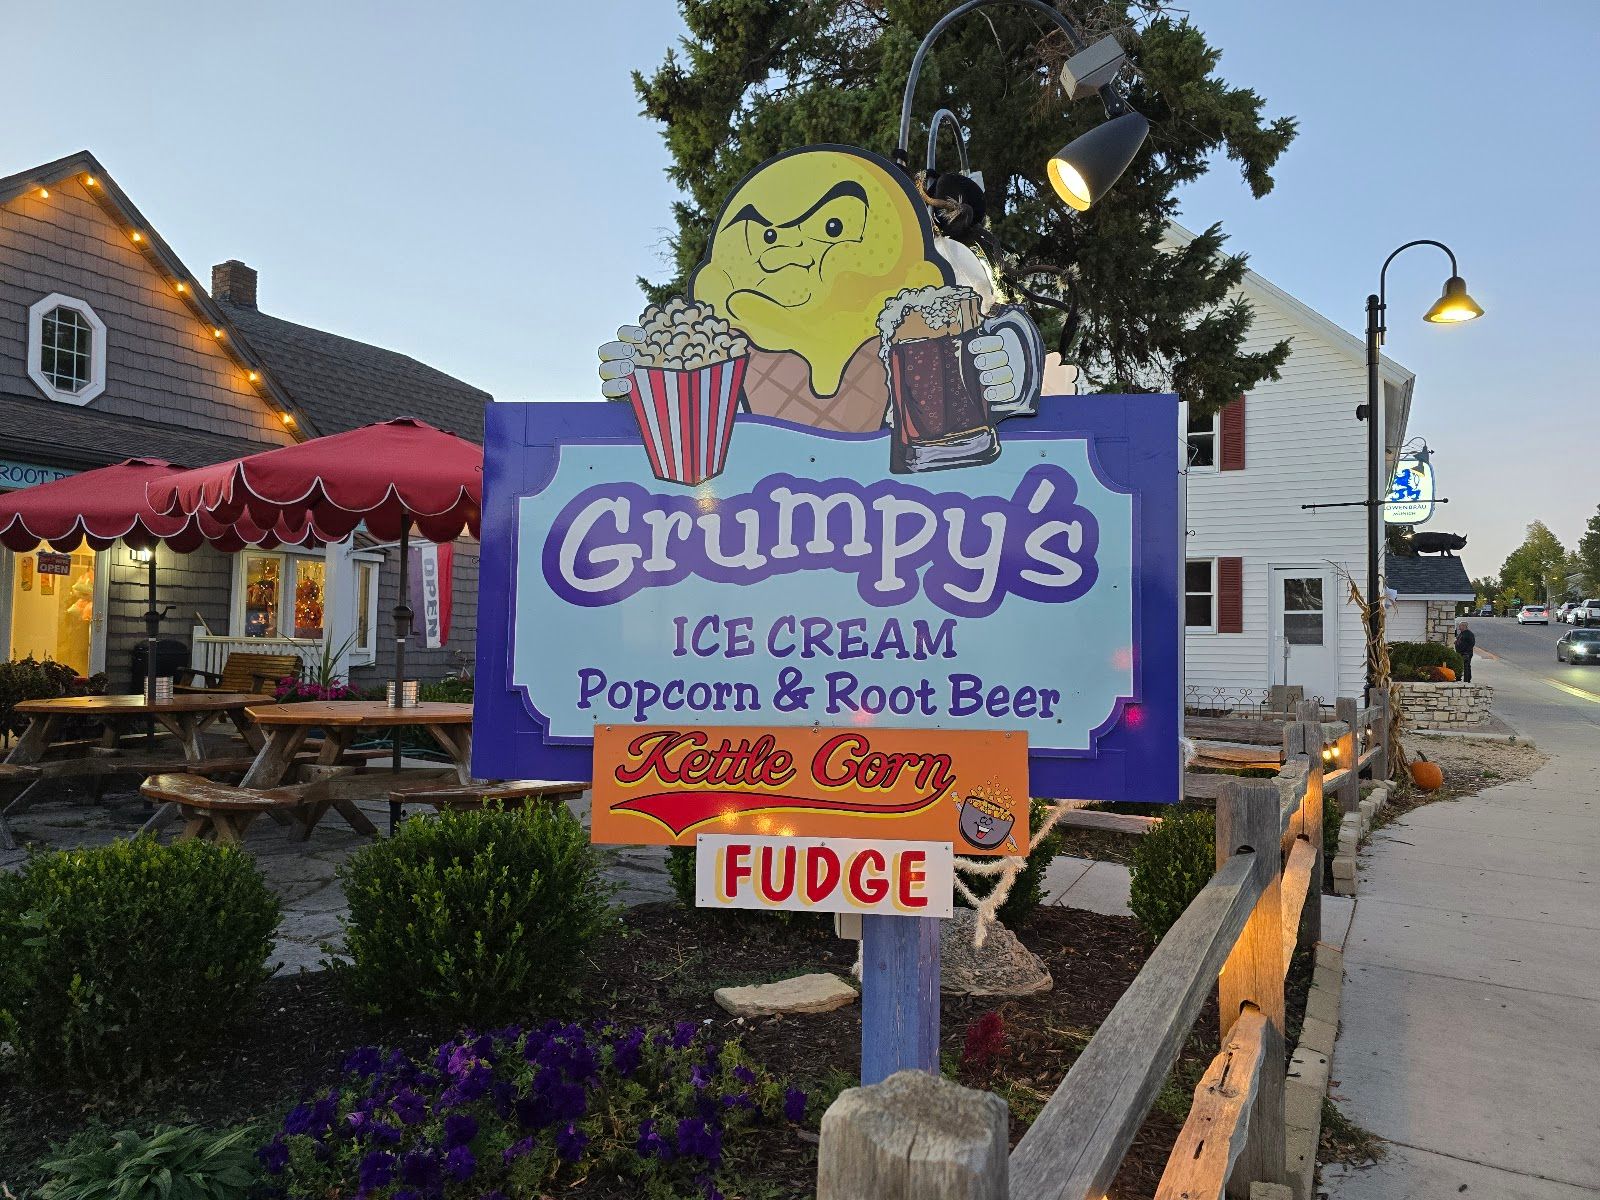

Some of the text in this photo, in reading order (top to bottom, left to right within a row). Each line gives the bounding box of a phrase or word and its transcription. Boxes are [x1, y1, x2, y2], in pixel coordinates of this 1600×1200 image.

[0, 465, 48, 485] ROOT
[40, 563, 68, 574] OPEN
[558, 477, 1084, 603] Grumpy's
[424, 557, 438, 638] OPEN
[672, 615, 958, 660] ICE CREAM
[576, 666, 1061, 722] Popcorn & Root Beer
[614, 730, 957, 794] Kettle Corn
[720, 844, 929, 911] FUDGE
